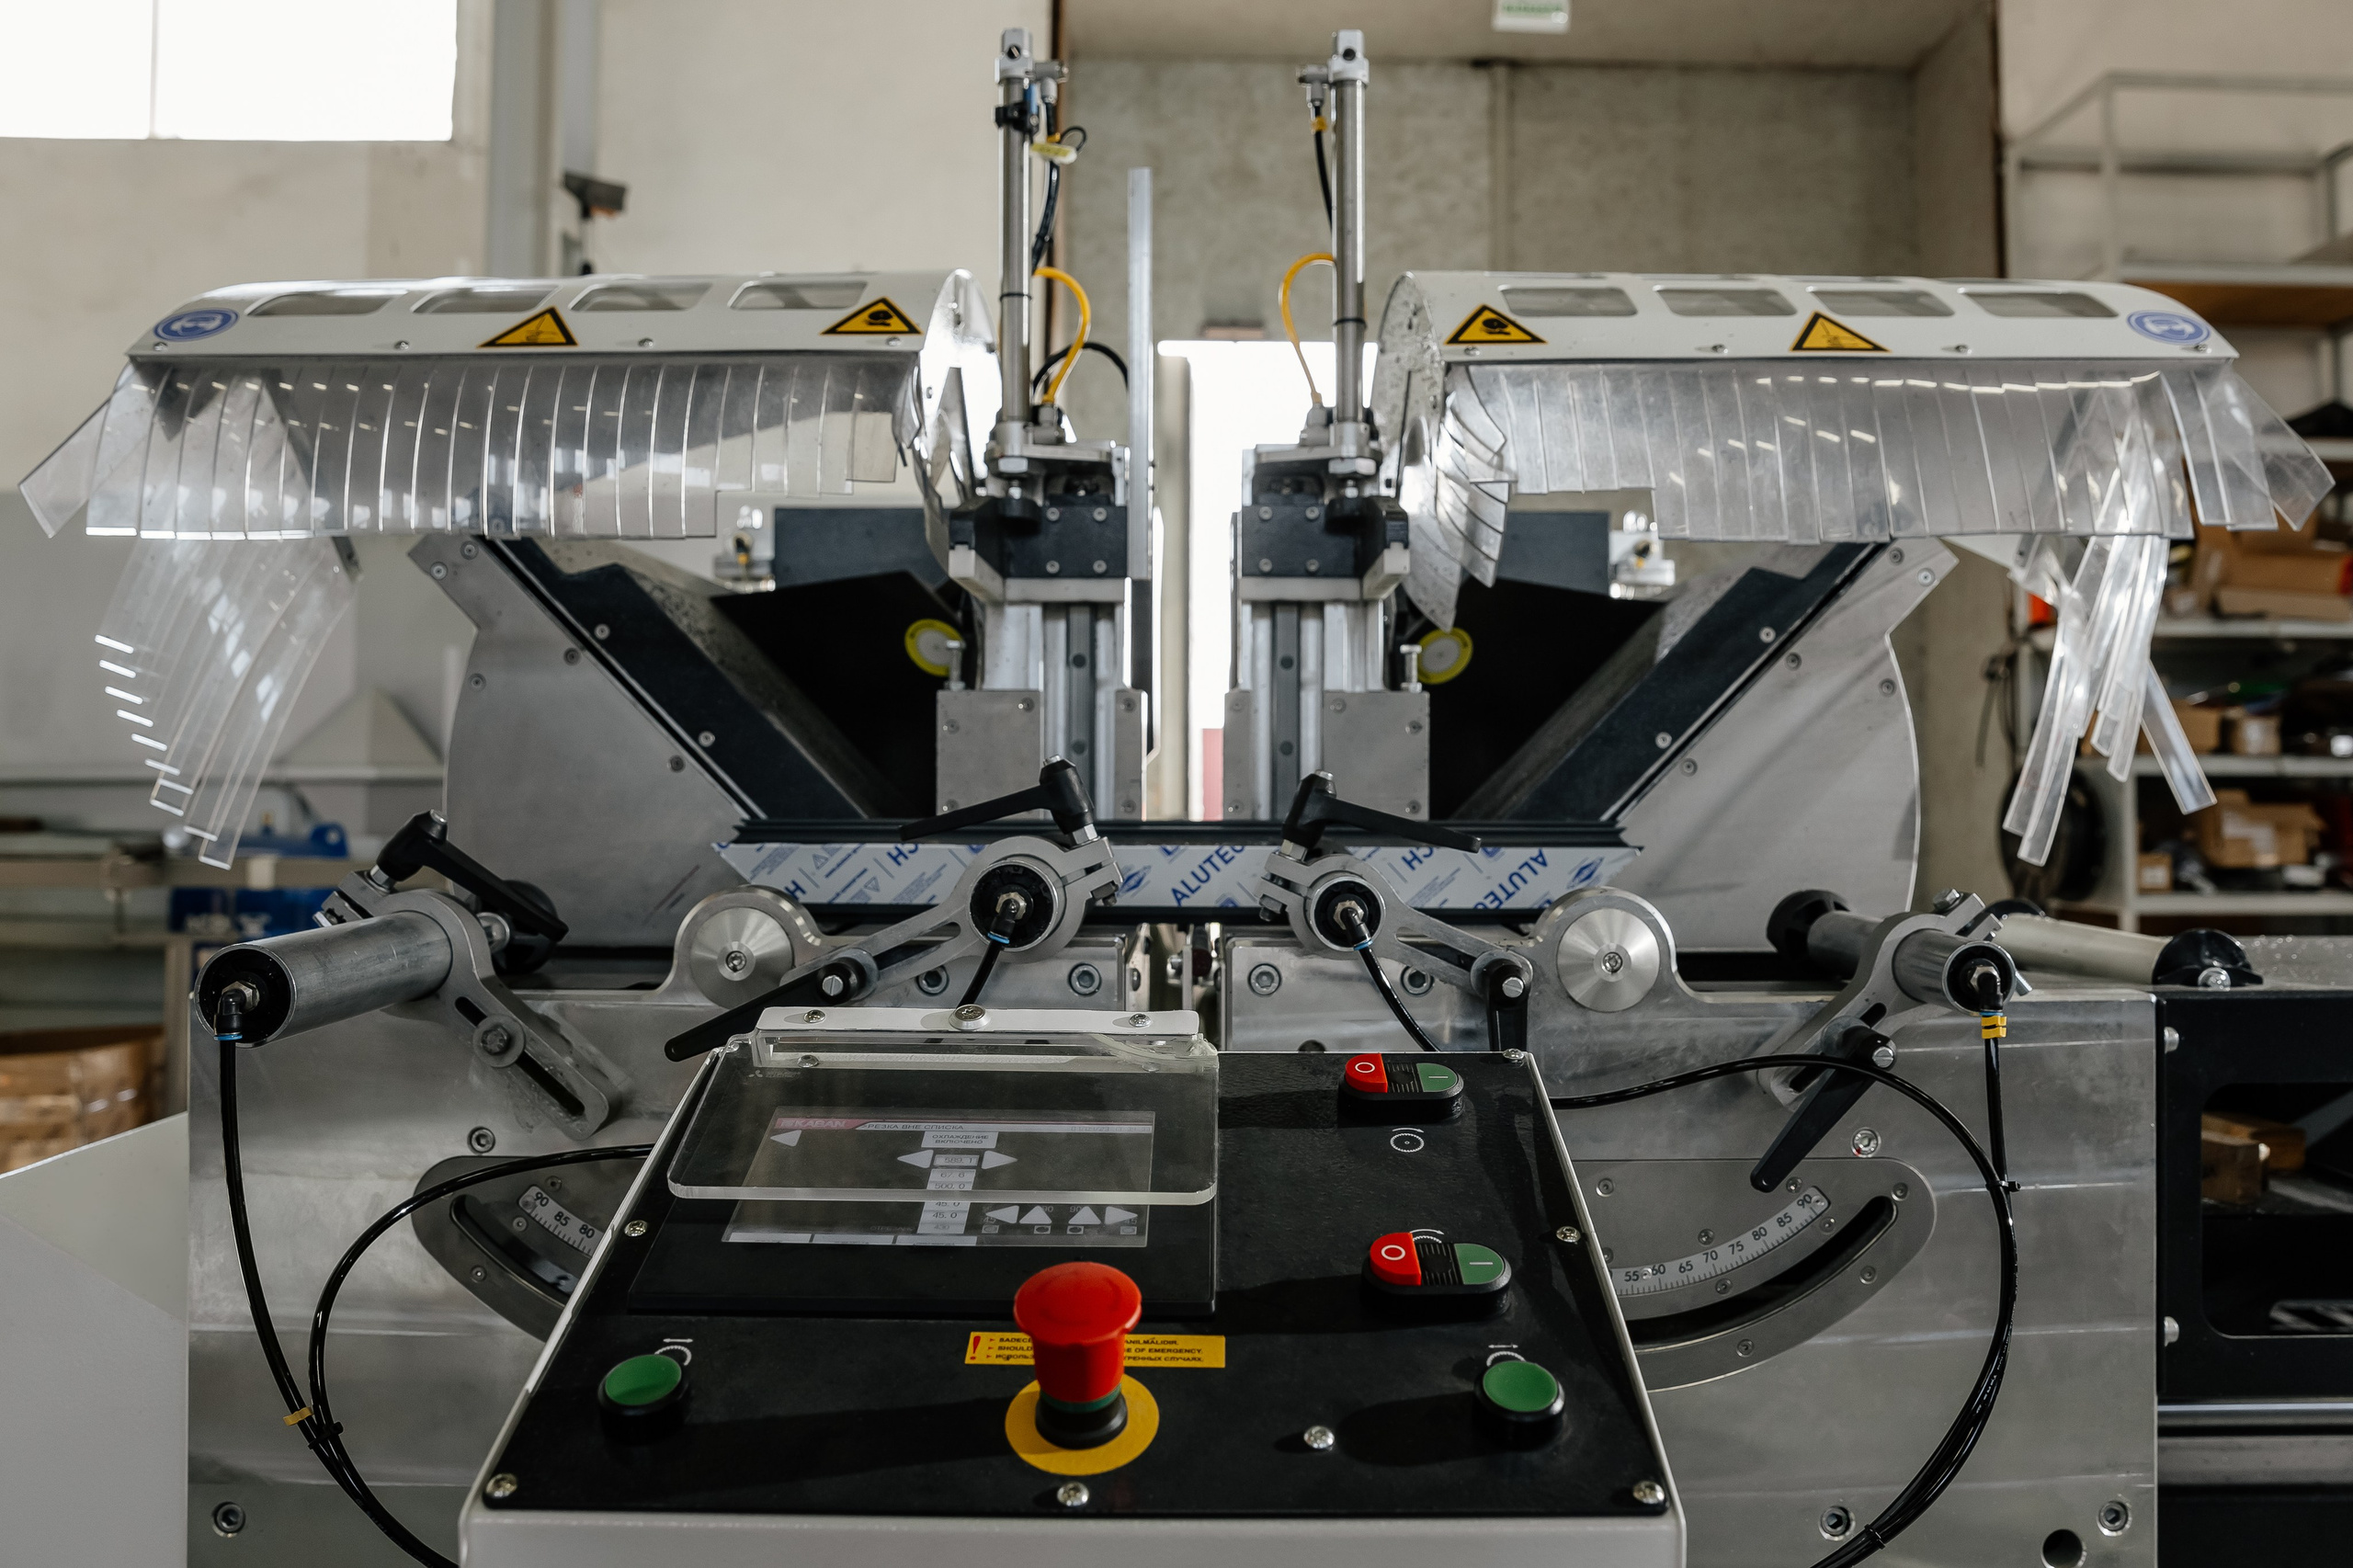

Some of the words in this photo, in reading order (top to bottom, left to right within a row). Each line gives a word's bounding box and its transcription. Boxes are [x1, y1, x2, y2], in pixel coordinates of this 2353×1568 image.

[534, 1191, 550, 1207] 90
[553, 1210, 571, 1226] 85
[579, 1223, 596, 1239] 80
[1624, 1269, 1640, 1282] 55
[1651, 1263, 1666, 1276] 60
[1678, 1260, 1694, 1273] 65
[1702, 1249, 1719, 1264] 70
[1728, 1241, 1745, 1256] 75
[1751, 1226, 1768, 1241] 80
[1776, 1212, 1792, 1228] 85
[1796, 1193, 1813, 1209] 90
